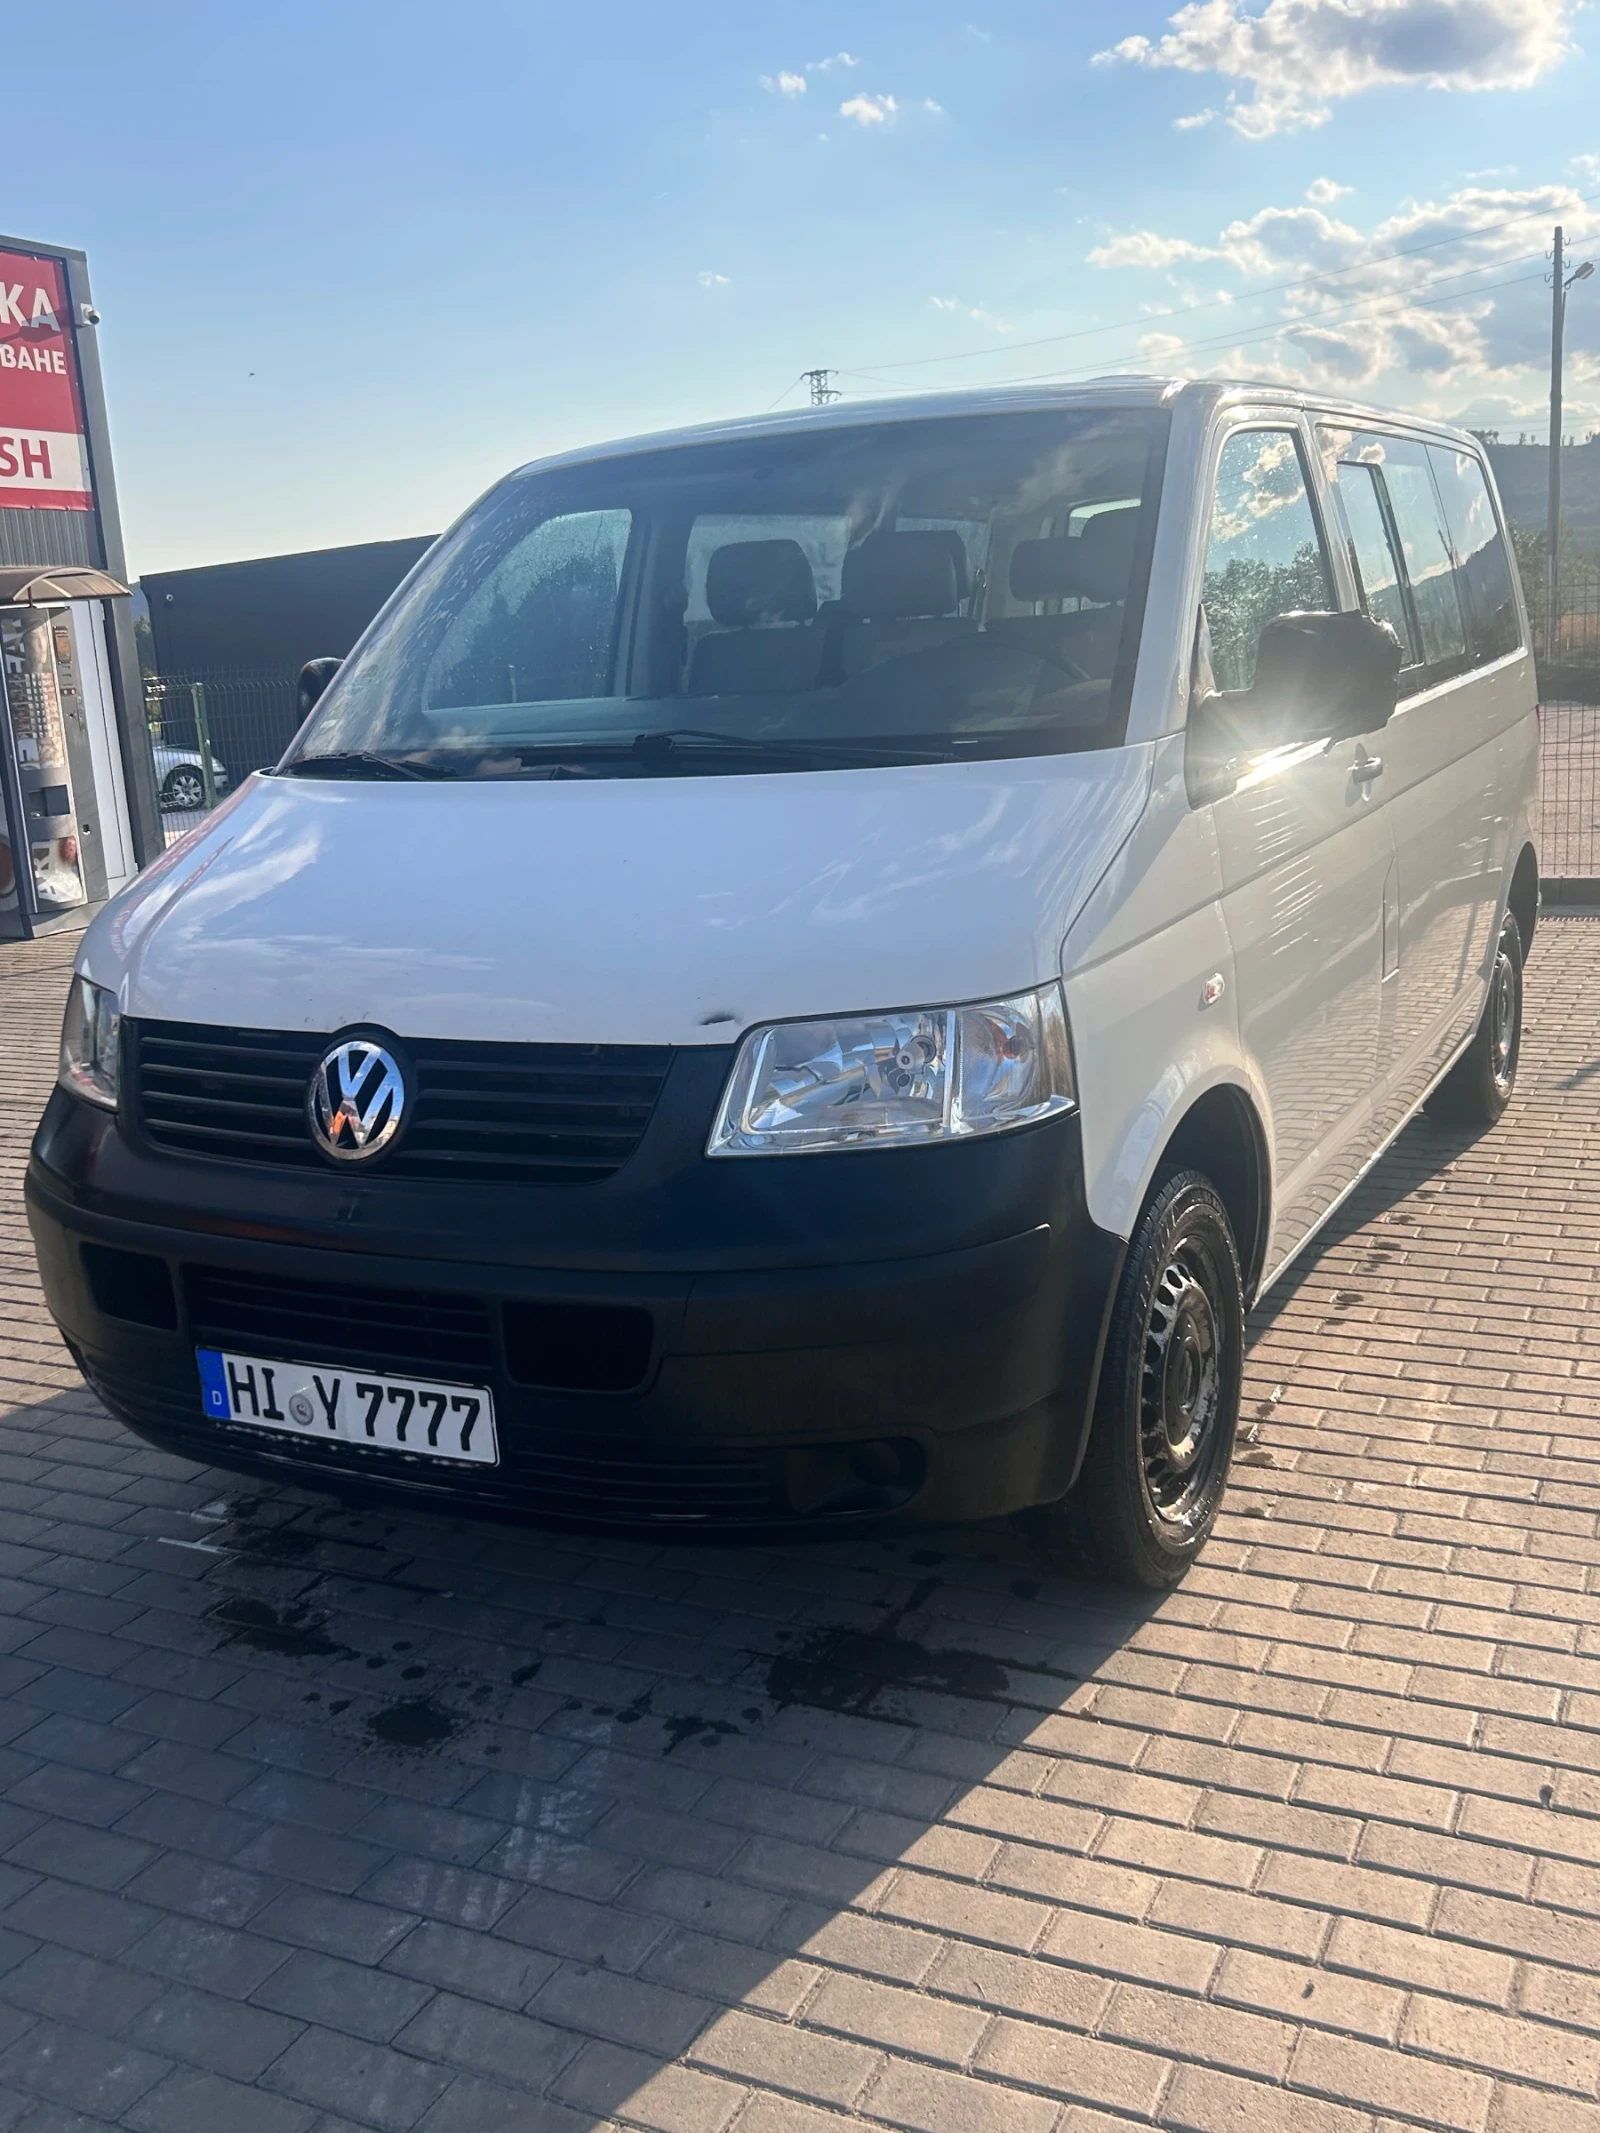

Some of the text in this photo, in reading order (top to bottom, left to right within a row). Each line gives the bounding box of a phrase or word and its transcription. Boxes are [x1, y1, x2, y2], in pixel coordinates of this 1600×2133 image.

[0, 343, 67, 375] ВАНЕ
[0, 436, 52, 479] SH
[211, 1389, 223, 1406] D
[227, 1361, 285, 1421] HI
[312, 1374, 341, 1431] Y
[356, 1381, 481, 1452] 7777
